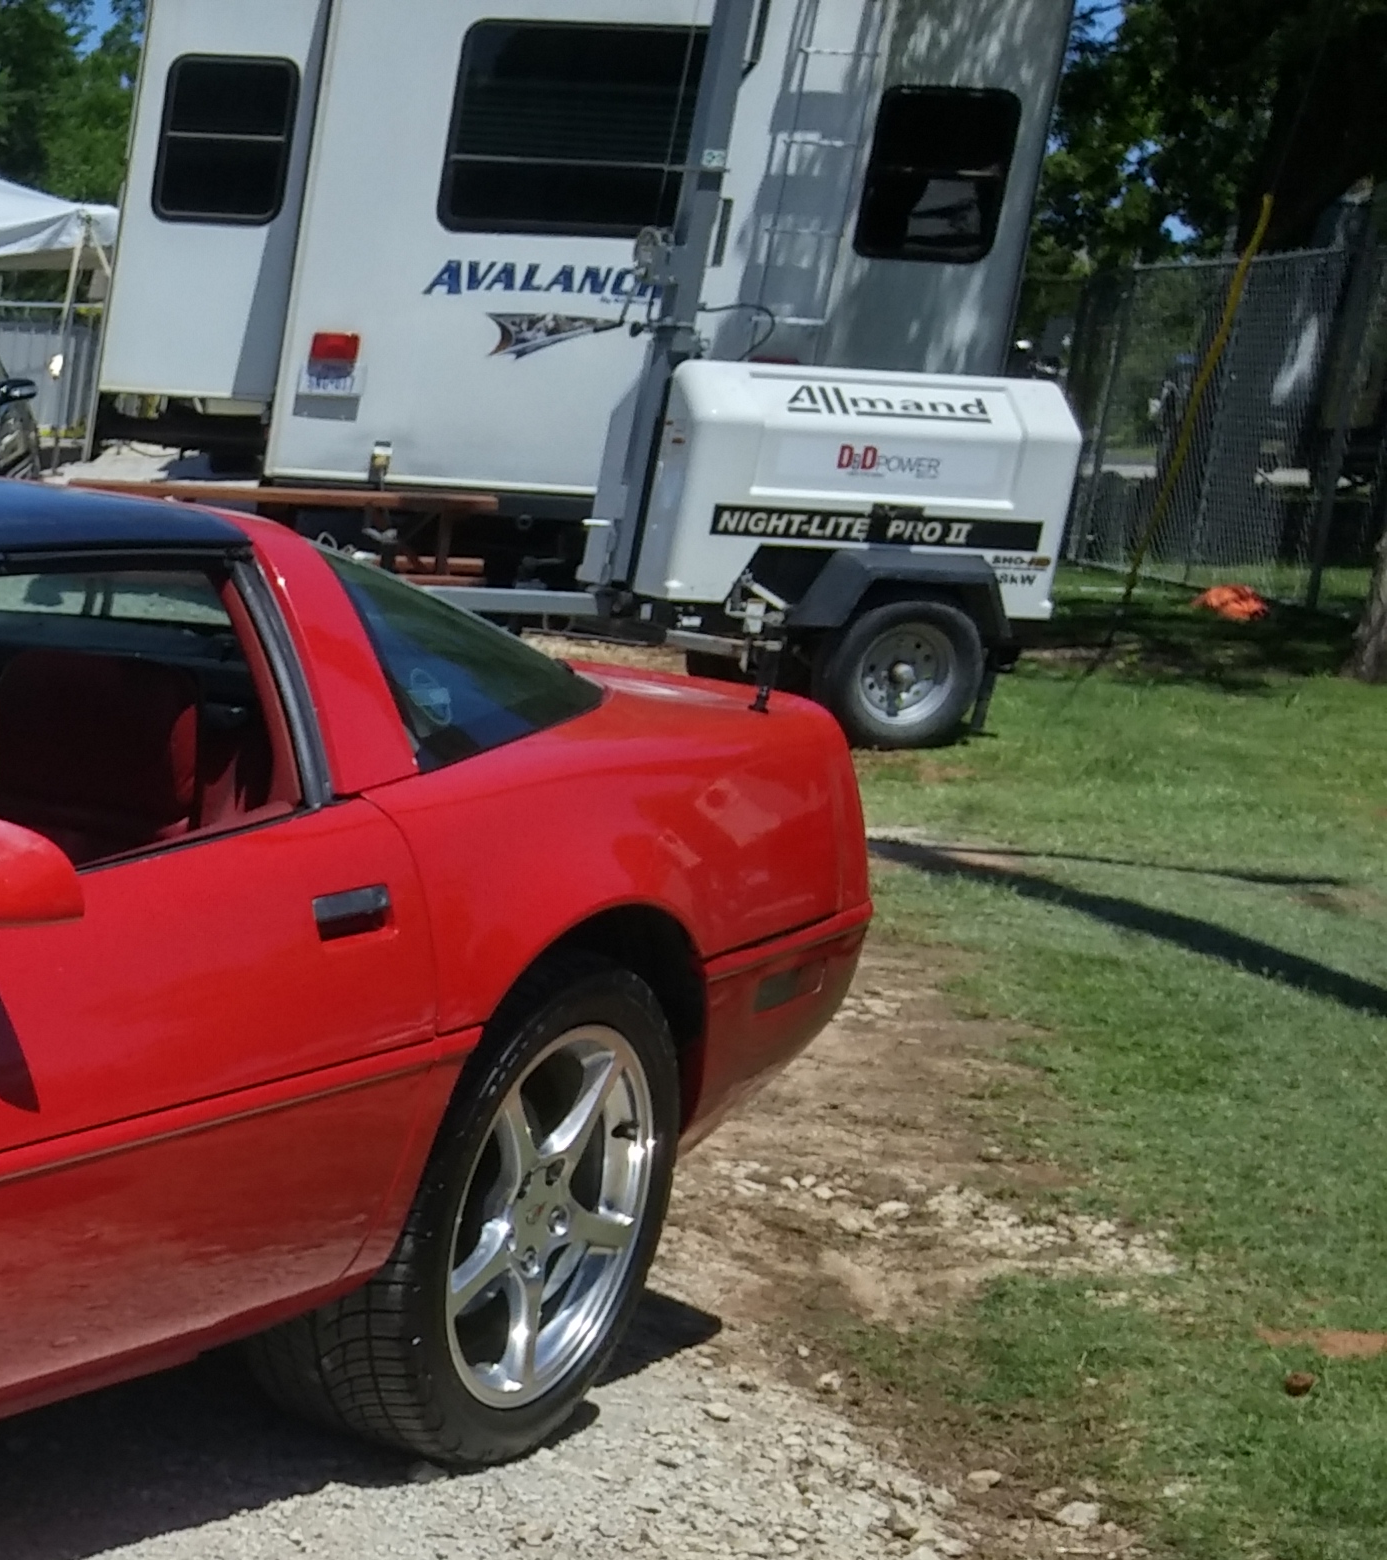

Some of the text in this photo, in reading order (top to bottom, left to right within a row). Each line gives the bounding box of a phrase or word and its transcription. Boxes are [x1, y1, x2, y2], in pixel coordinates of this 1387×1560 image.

[787, 384, 990, 418] Allmand
[716, 510, 972, 544] NIGHT-LITE PRO II
